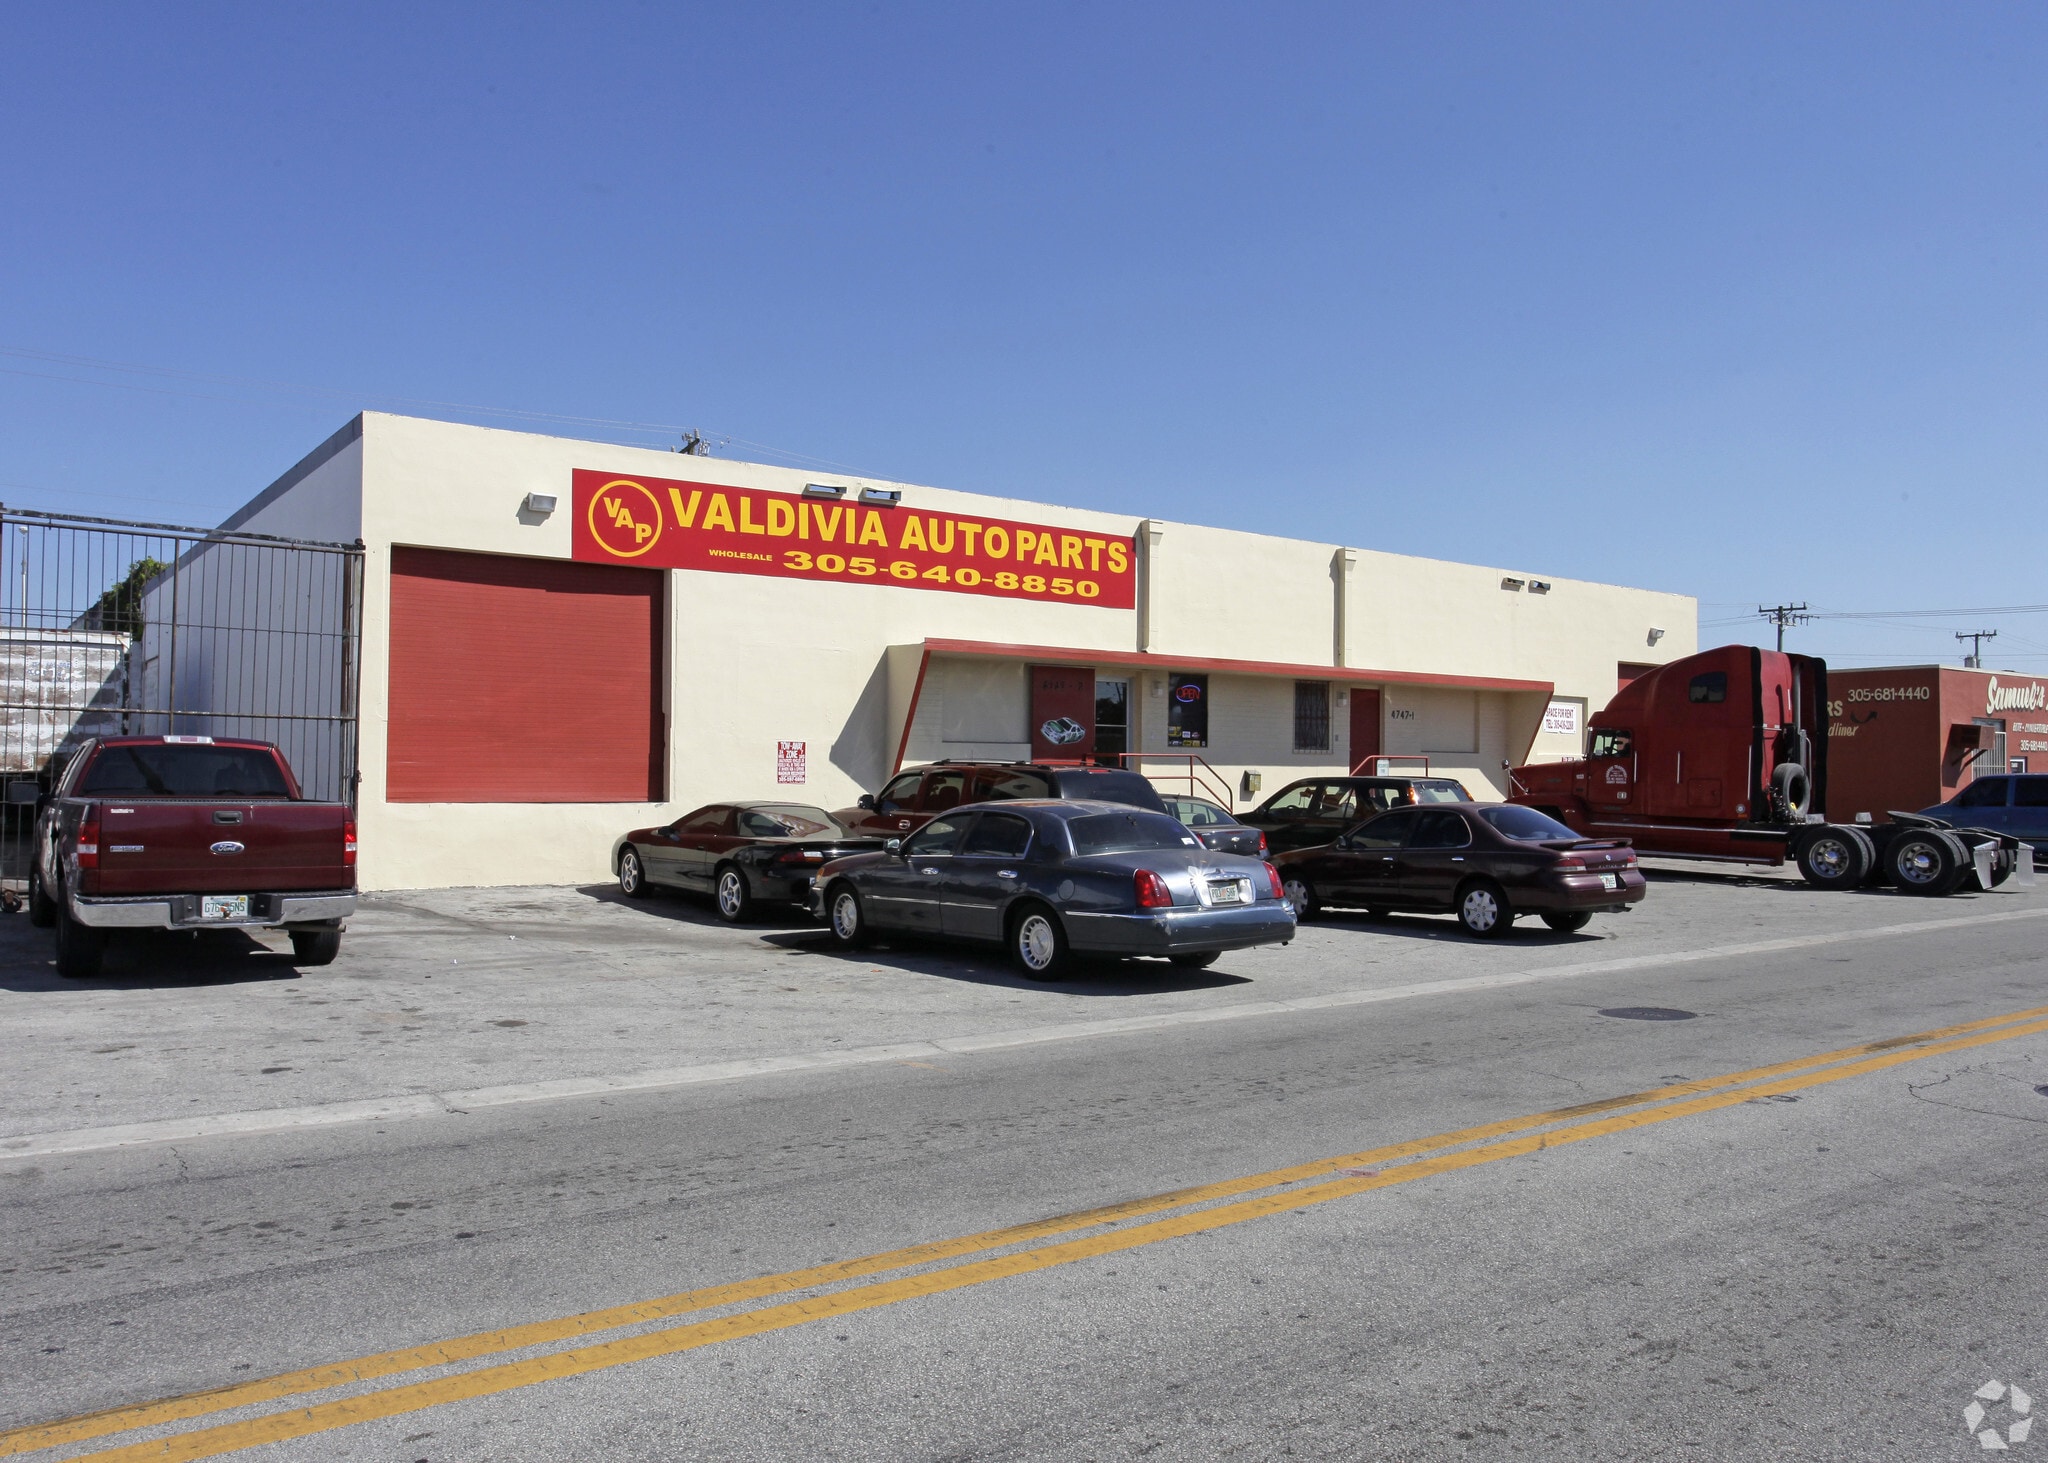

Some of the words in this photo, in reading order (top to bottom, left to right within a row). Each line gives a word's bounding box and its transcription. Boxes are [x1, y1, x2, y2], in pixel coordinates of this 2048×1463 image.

[668, 487, 889, 548] VALDIVIA
[709, 549, 773, 562] WHOLESALE
[783, 550, 1100, 598] 305-640-8850
[1176, 687, 1200, 700] OPEN
[1847, 686, 1930, 702] 305-681-4440
[1986, 675, 2045, 714] Samuel's
[1391, 709, 1415, 721] 4747-1
[1565, 708, 1574, 719] RENT
[1827, 700, 1843, 717] RS
[1827, 723, 1859, 737] dliner
